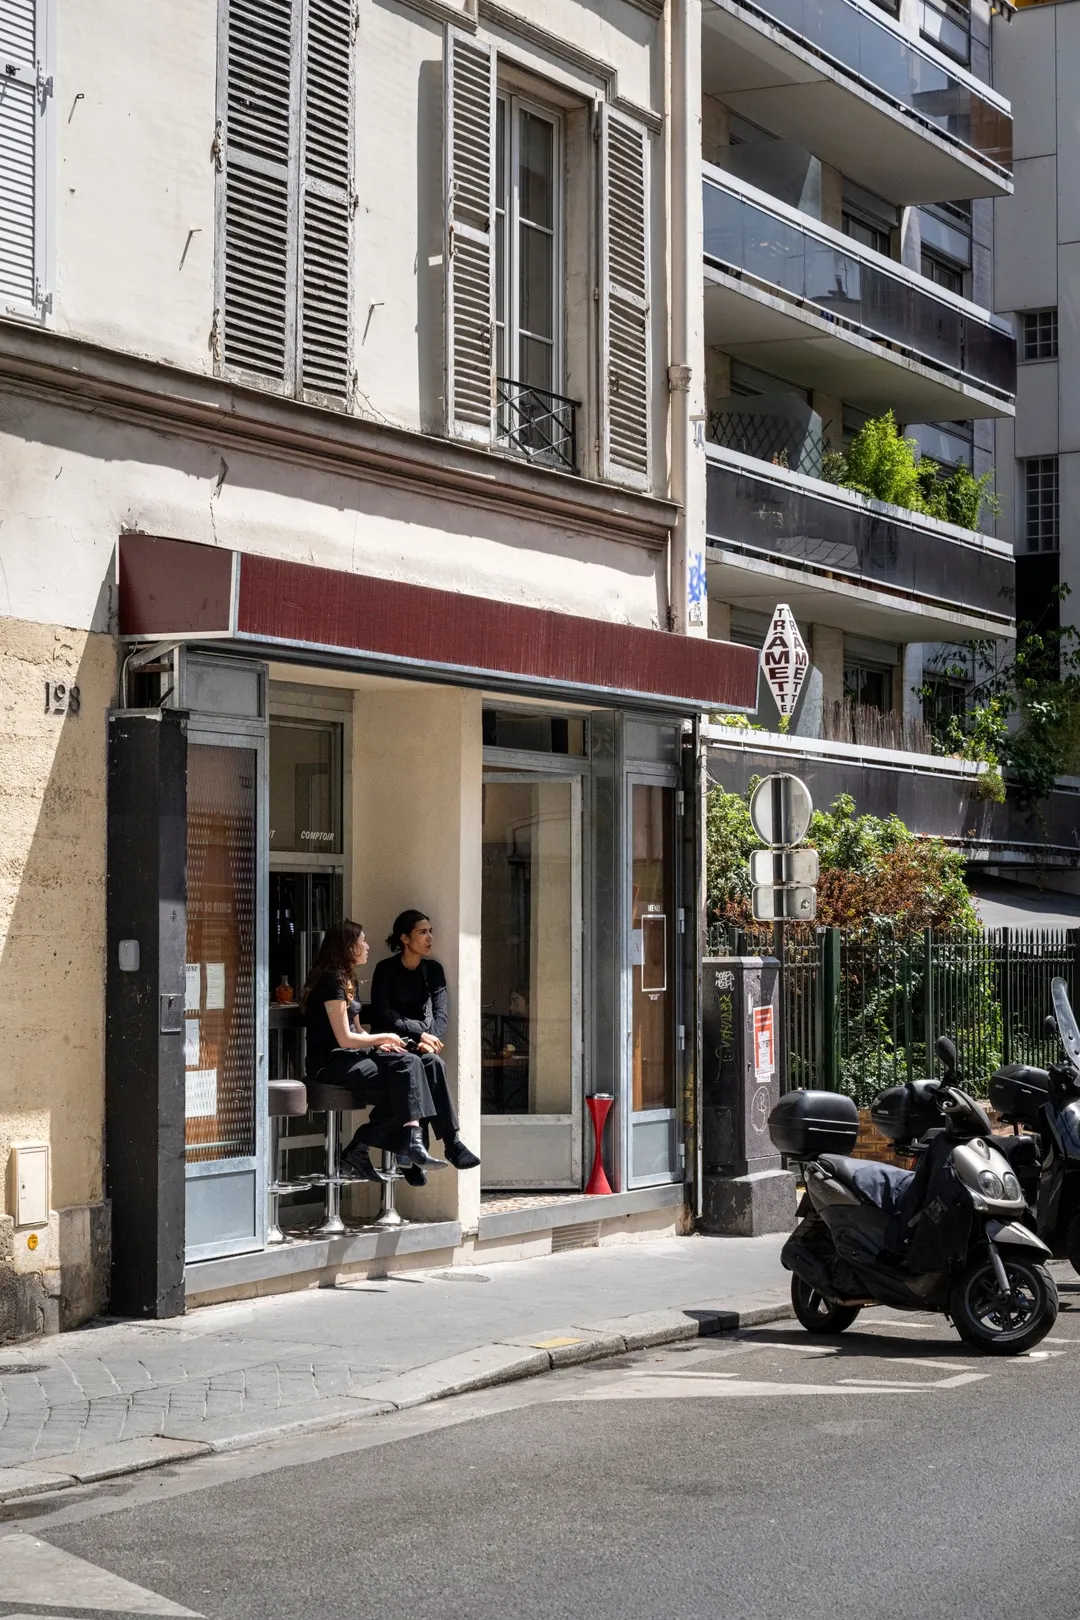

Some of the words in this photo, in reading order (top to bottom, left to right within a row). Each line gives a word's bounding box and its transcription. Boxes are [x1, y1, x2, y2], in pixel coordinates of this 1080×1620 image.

[765, 608, 789, 712] TRÂMETTE
[300, 830, 335, 841] COMPTOIR
[647, 904, 661, 912] MENU
